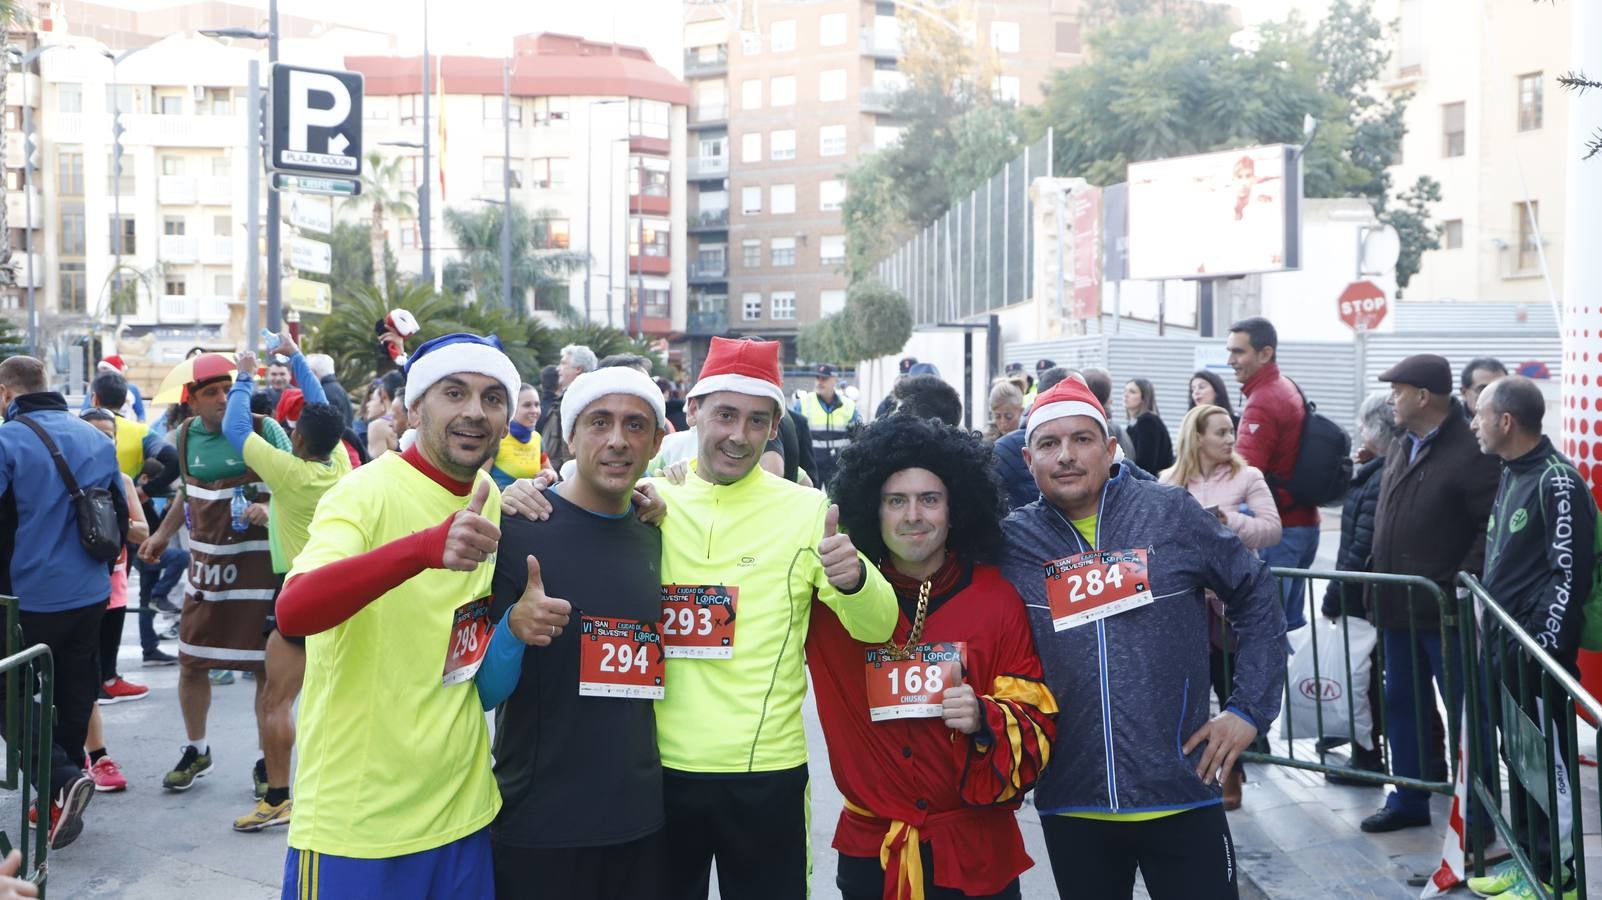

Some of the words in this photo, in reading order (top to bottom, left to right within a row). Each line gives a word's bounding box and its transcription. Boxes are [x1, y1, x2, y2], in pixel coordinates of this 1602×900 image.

[288, 69, 351, 152] P
[286, 152, 317, 163] PLAZA
[1341, 297, 1385, 315] STOP
[1045, 565, 1055, 577] VI
[1060, 559, 1094, 573] SILVESTRE
[1067, 563, 1123, 603] 284
[695, 595, 731, 605] LORCA
[583, 622, 593, 633] VI
[594, 620, 609, 628] SAN
[617, 622, 636, 630] CIUDAD
[663, 607, 713, 636] 293
[597, 628, 629, 637] SILVESTRE
[634, 631, 660, 643] LORCA
[453, 622, 478, 660] 298
[600, 642, 649, 674] 294
[867, 651, 877, 662] VI
[922, 652, 960, 662] LORCA
[888, 665, 944, 695] 168
[1305, 681, 1336, 697] KA
